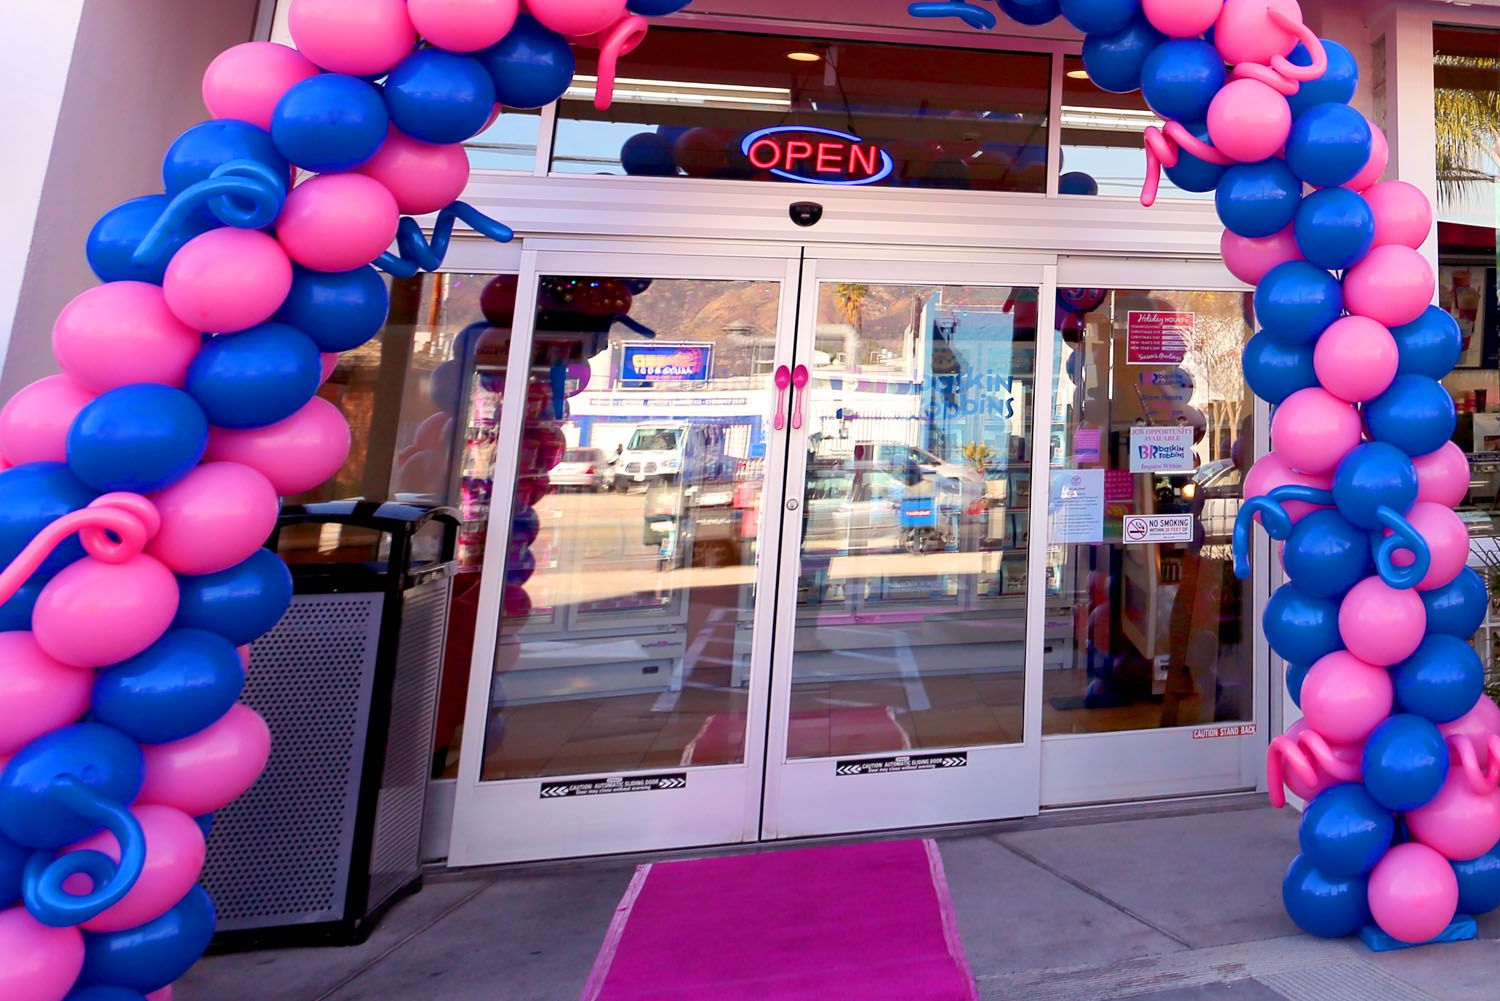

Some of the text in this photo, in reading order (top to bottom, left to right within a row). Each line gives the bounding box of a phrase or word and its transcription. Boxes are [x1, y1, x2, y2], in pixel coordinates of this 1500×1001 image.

[748, 140, 877, 175] OPEN
[1138, 314, 1163, 325] Holiday
[1145, 427, 1192, 435] OPPORTUNITY
[1138, 444, 1158, 459] BR
[1160, 519, 1188, 527] SMOKING
[1194, 726, 1256, 738] CAUTION STAND BACK
[594, 781, 624, 789] AUTOMATIC
